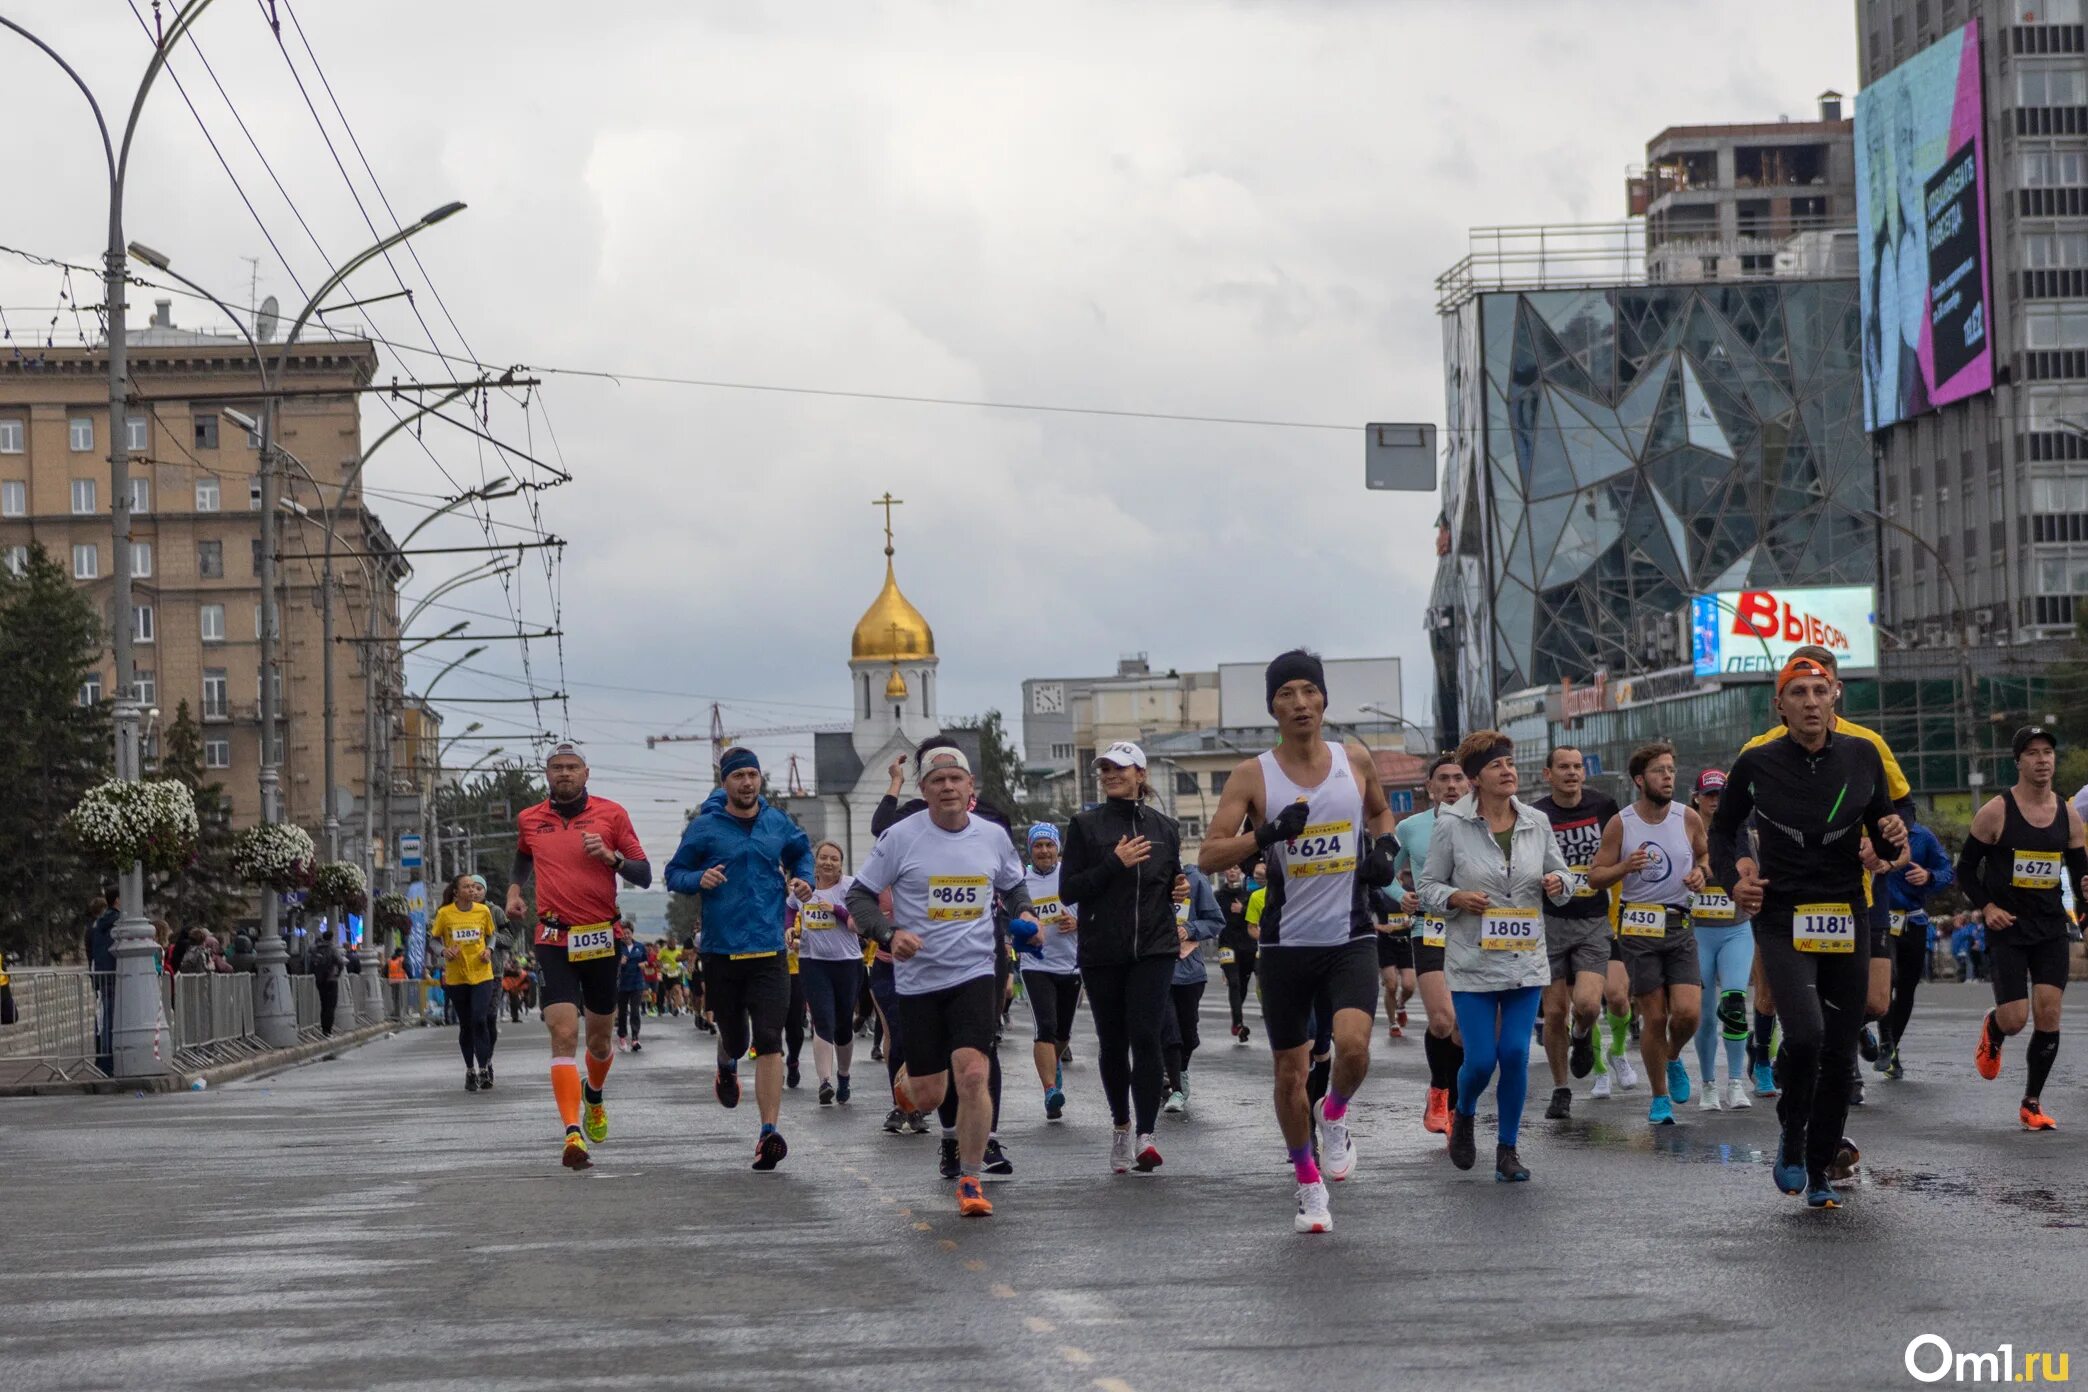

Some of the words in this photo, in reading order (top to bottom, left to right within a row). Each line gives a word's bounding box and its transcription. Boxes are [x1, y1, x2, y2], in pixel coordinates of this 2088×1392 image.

[1726, 655, 1786, 672] ДЕПУТ
[1556, 823, 1602, 847] RUN
[1301, 836, 1341, 857] 624
[2026, 861, 2052, 875] 672
[941, 887, 976, 903] 865
[1699, 895, 1728, 907] 1175
[810, 911, 829, 920] 416
[1034, 903, 1057, 915] 740
[1629, 912, 1656, 924] 430
[1805, 916, 1847, 934] 1181
[456, 930, 476, 938] 1287
[1489, 921, 1531, 936] 1805
[574, 932, 608, 948] 1035
